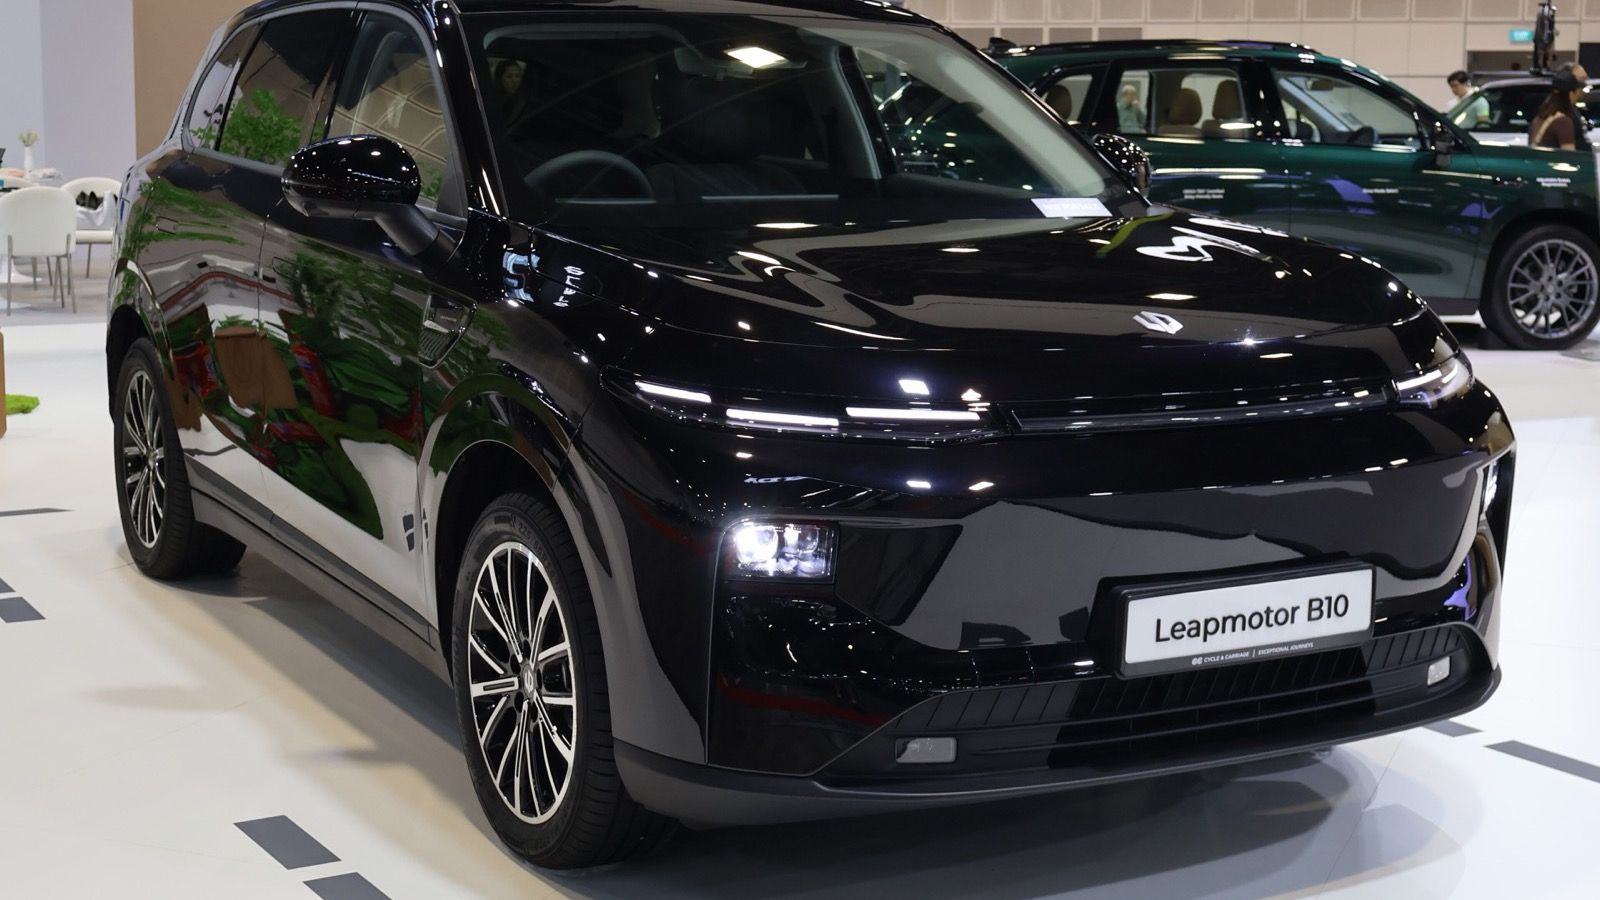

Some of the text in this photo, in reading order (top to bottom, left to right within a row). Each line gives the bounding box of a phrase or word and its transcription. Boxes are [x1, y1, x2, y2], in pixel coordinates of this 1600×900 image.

[1155, 594, 1349, 642] Leapmotor B10
[1225, 651, 1249, 660] CARRIAGE
[1258, 646, 1289, 655] EXCEPTIONAL
